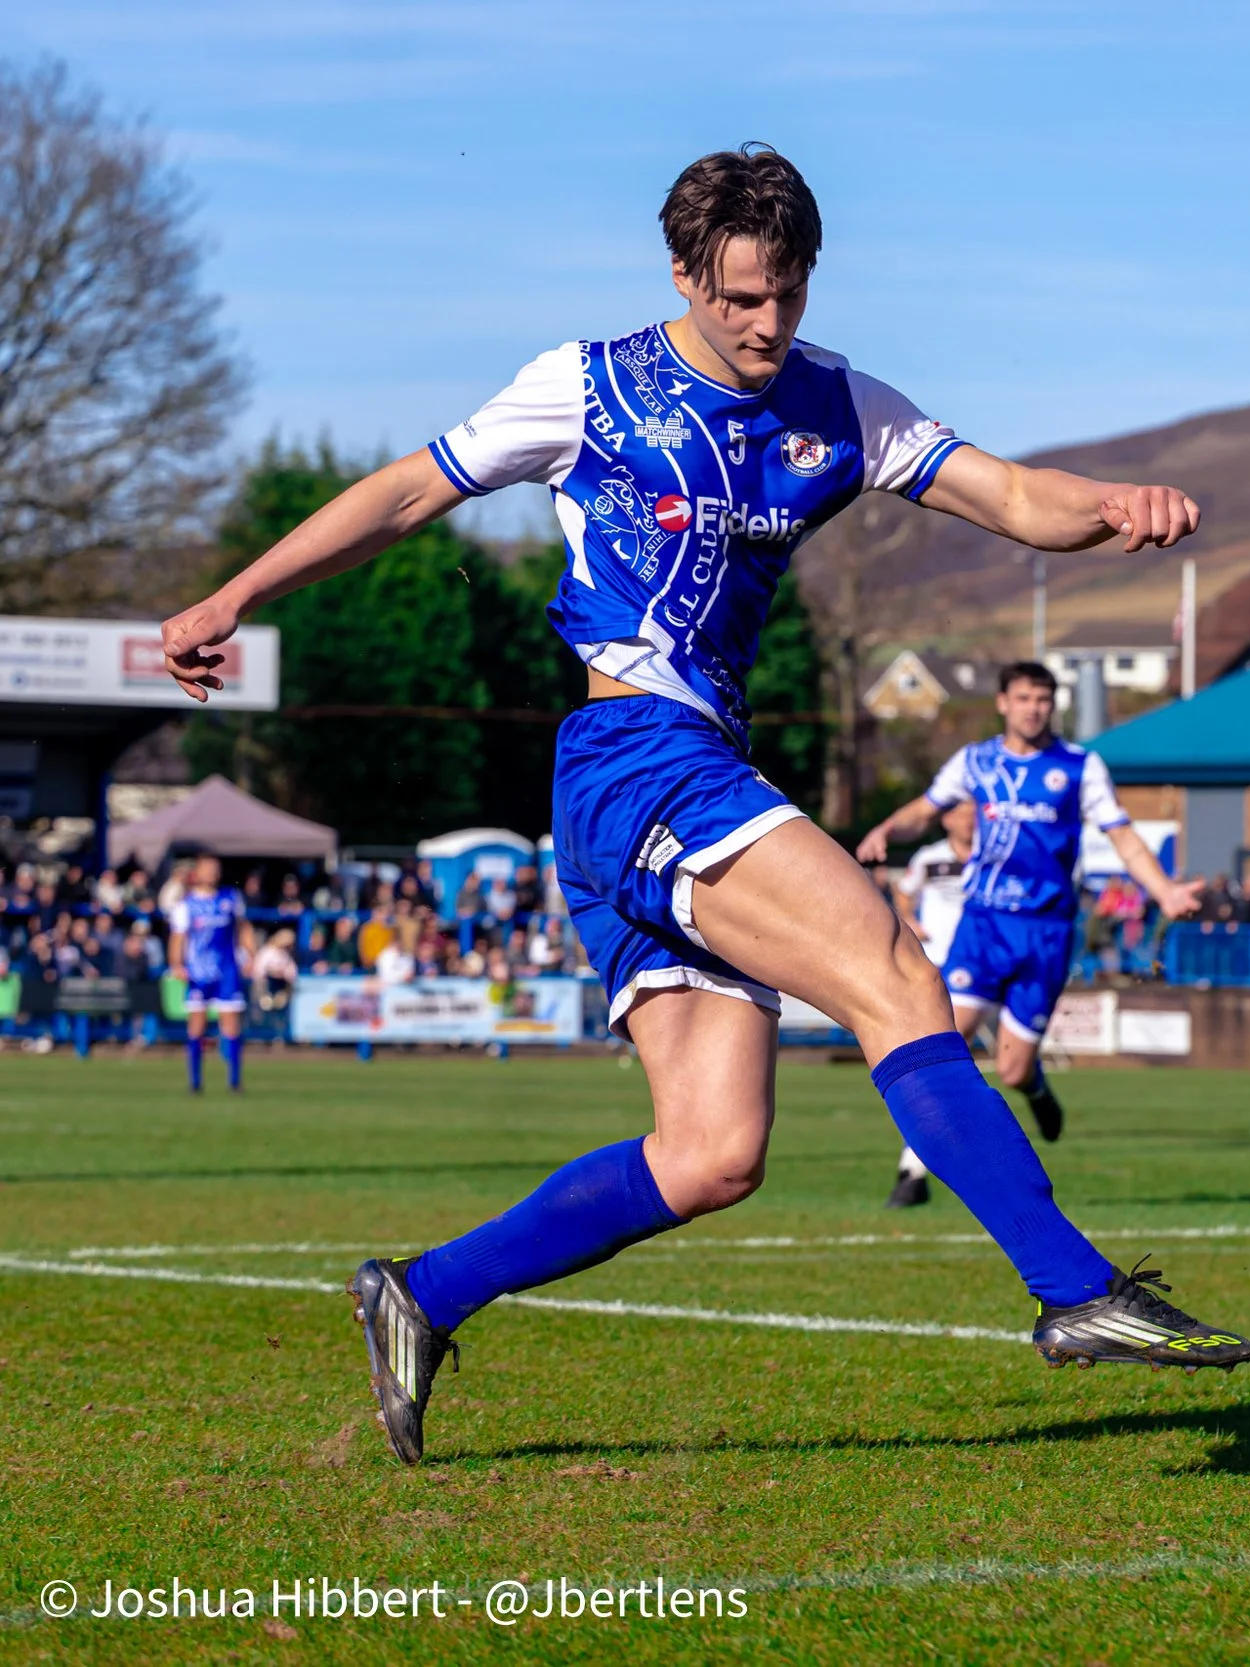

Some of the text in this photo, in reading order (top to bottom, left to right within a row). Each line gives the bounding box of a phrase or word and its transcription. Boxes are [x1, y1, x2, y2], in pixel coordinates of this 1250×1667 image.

[617, 353, 649, 386] ABSQUE
[635, 426, 691, 440] MATCHWINNER
[727, 419, 747, 466] 5
[786, 462, 827, 474] FOOTBALL CLUB
[695, 495, 806, 542] Fidelis
[646, 530, 671, 553] NIHI
[692, 507, 718, 585] CLU
[1167, 1335, 1242, 1352] F50
